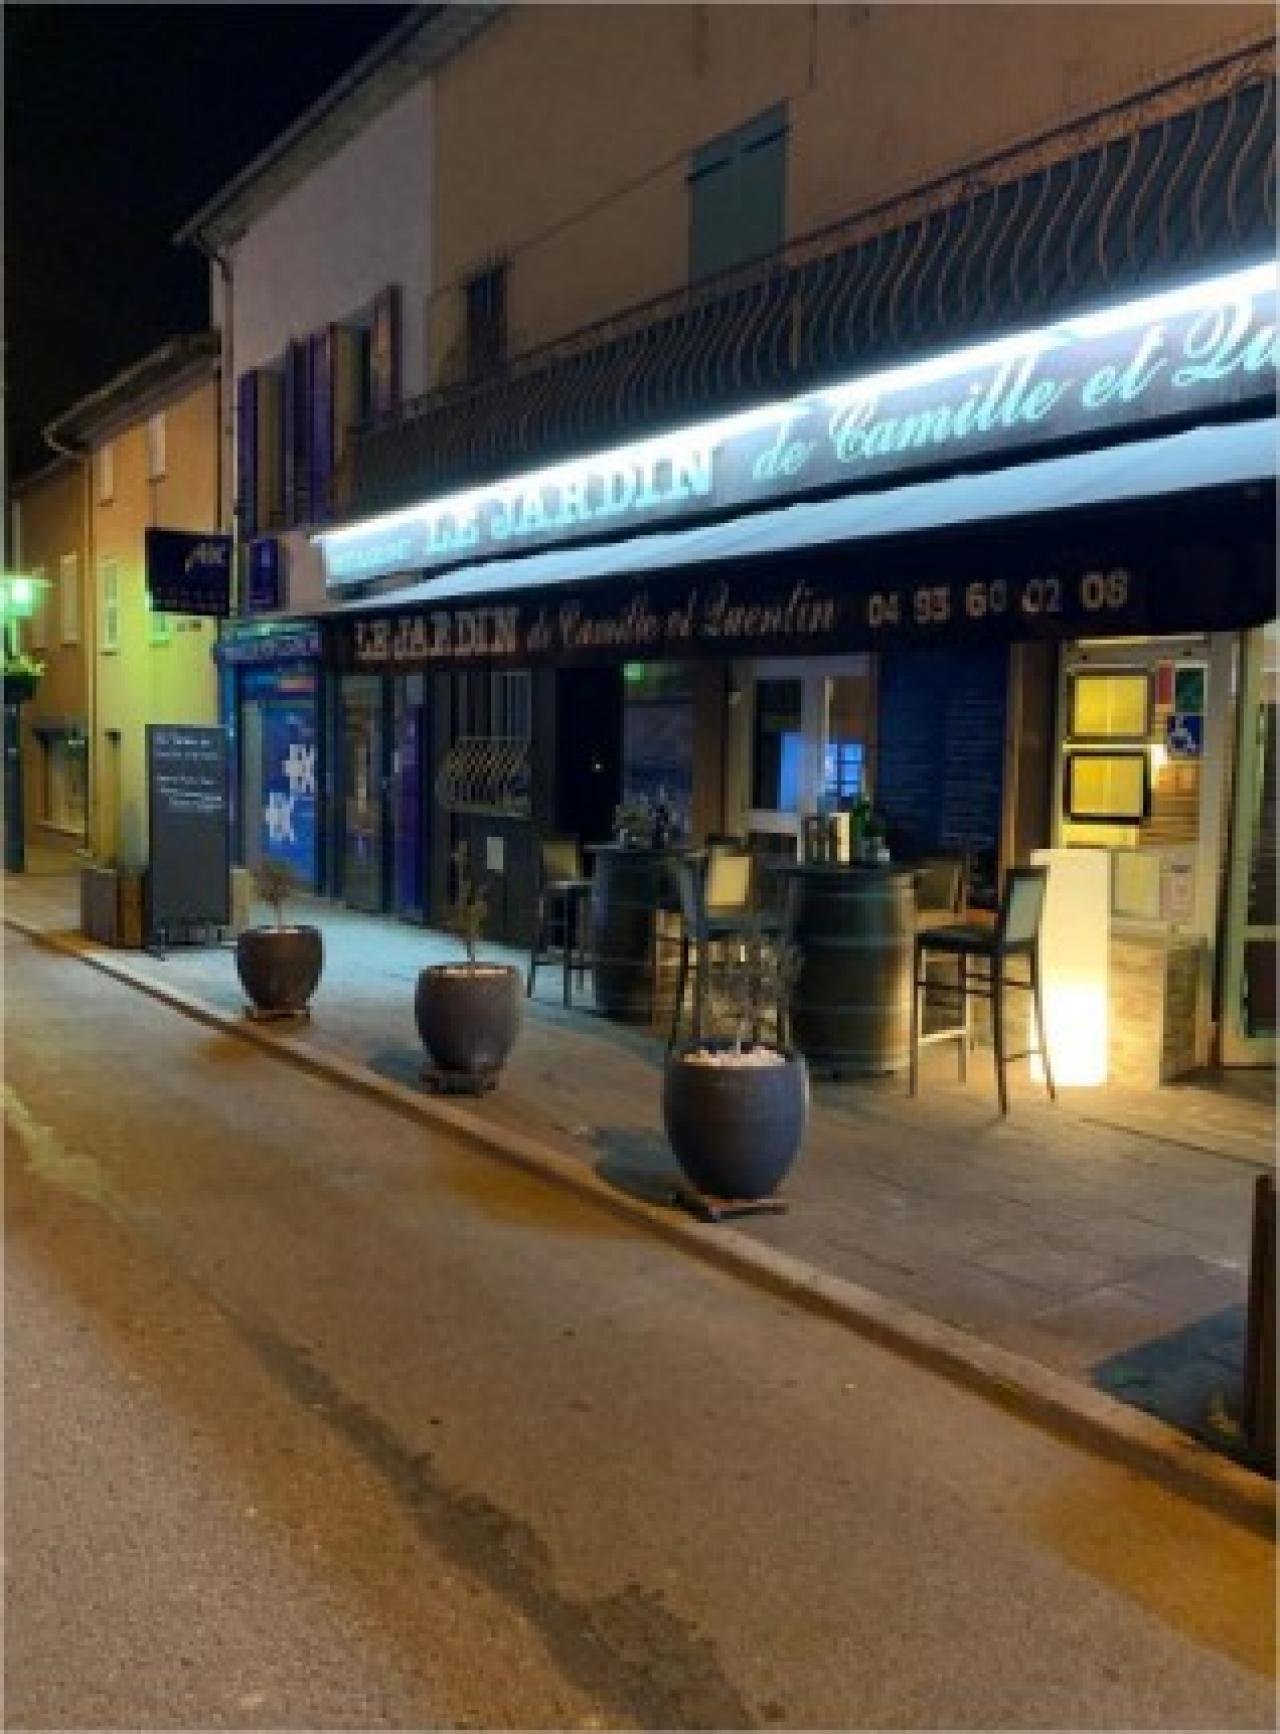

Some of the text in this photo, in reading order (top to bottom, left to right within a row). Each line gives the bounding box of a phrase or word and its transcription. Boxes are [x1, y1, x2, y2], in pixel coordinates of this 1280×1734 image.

[490, 444, 717, 540] JARDIN
[752, 411, 812, 481] de
[828, 348, 1073, 464] Camille
[1082, 321, 1168, 409] et
[353, 616, 392, 662] LE
[393, 604, 520, 660] JARDIN
[866, 590, 902, 629] 04
[964, 577, 1009, 620] 60
[1020, 575, 1064, 615] 02
